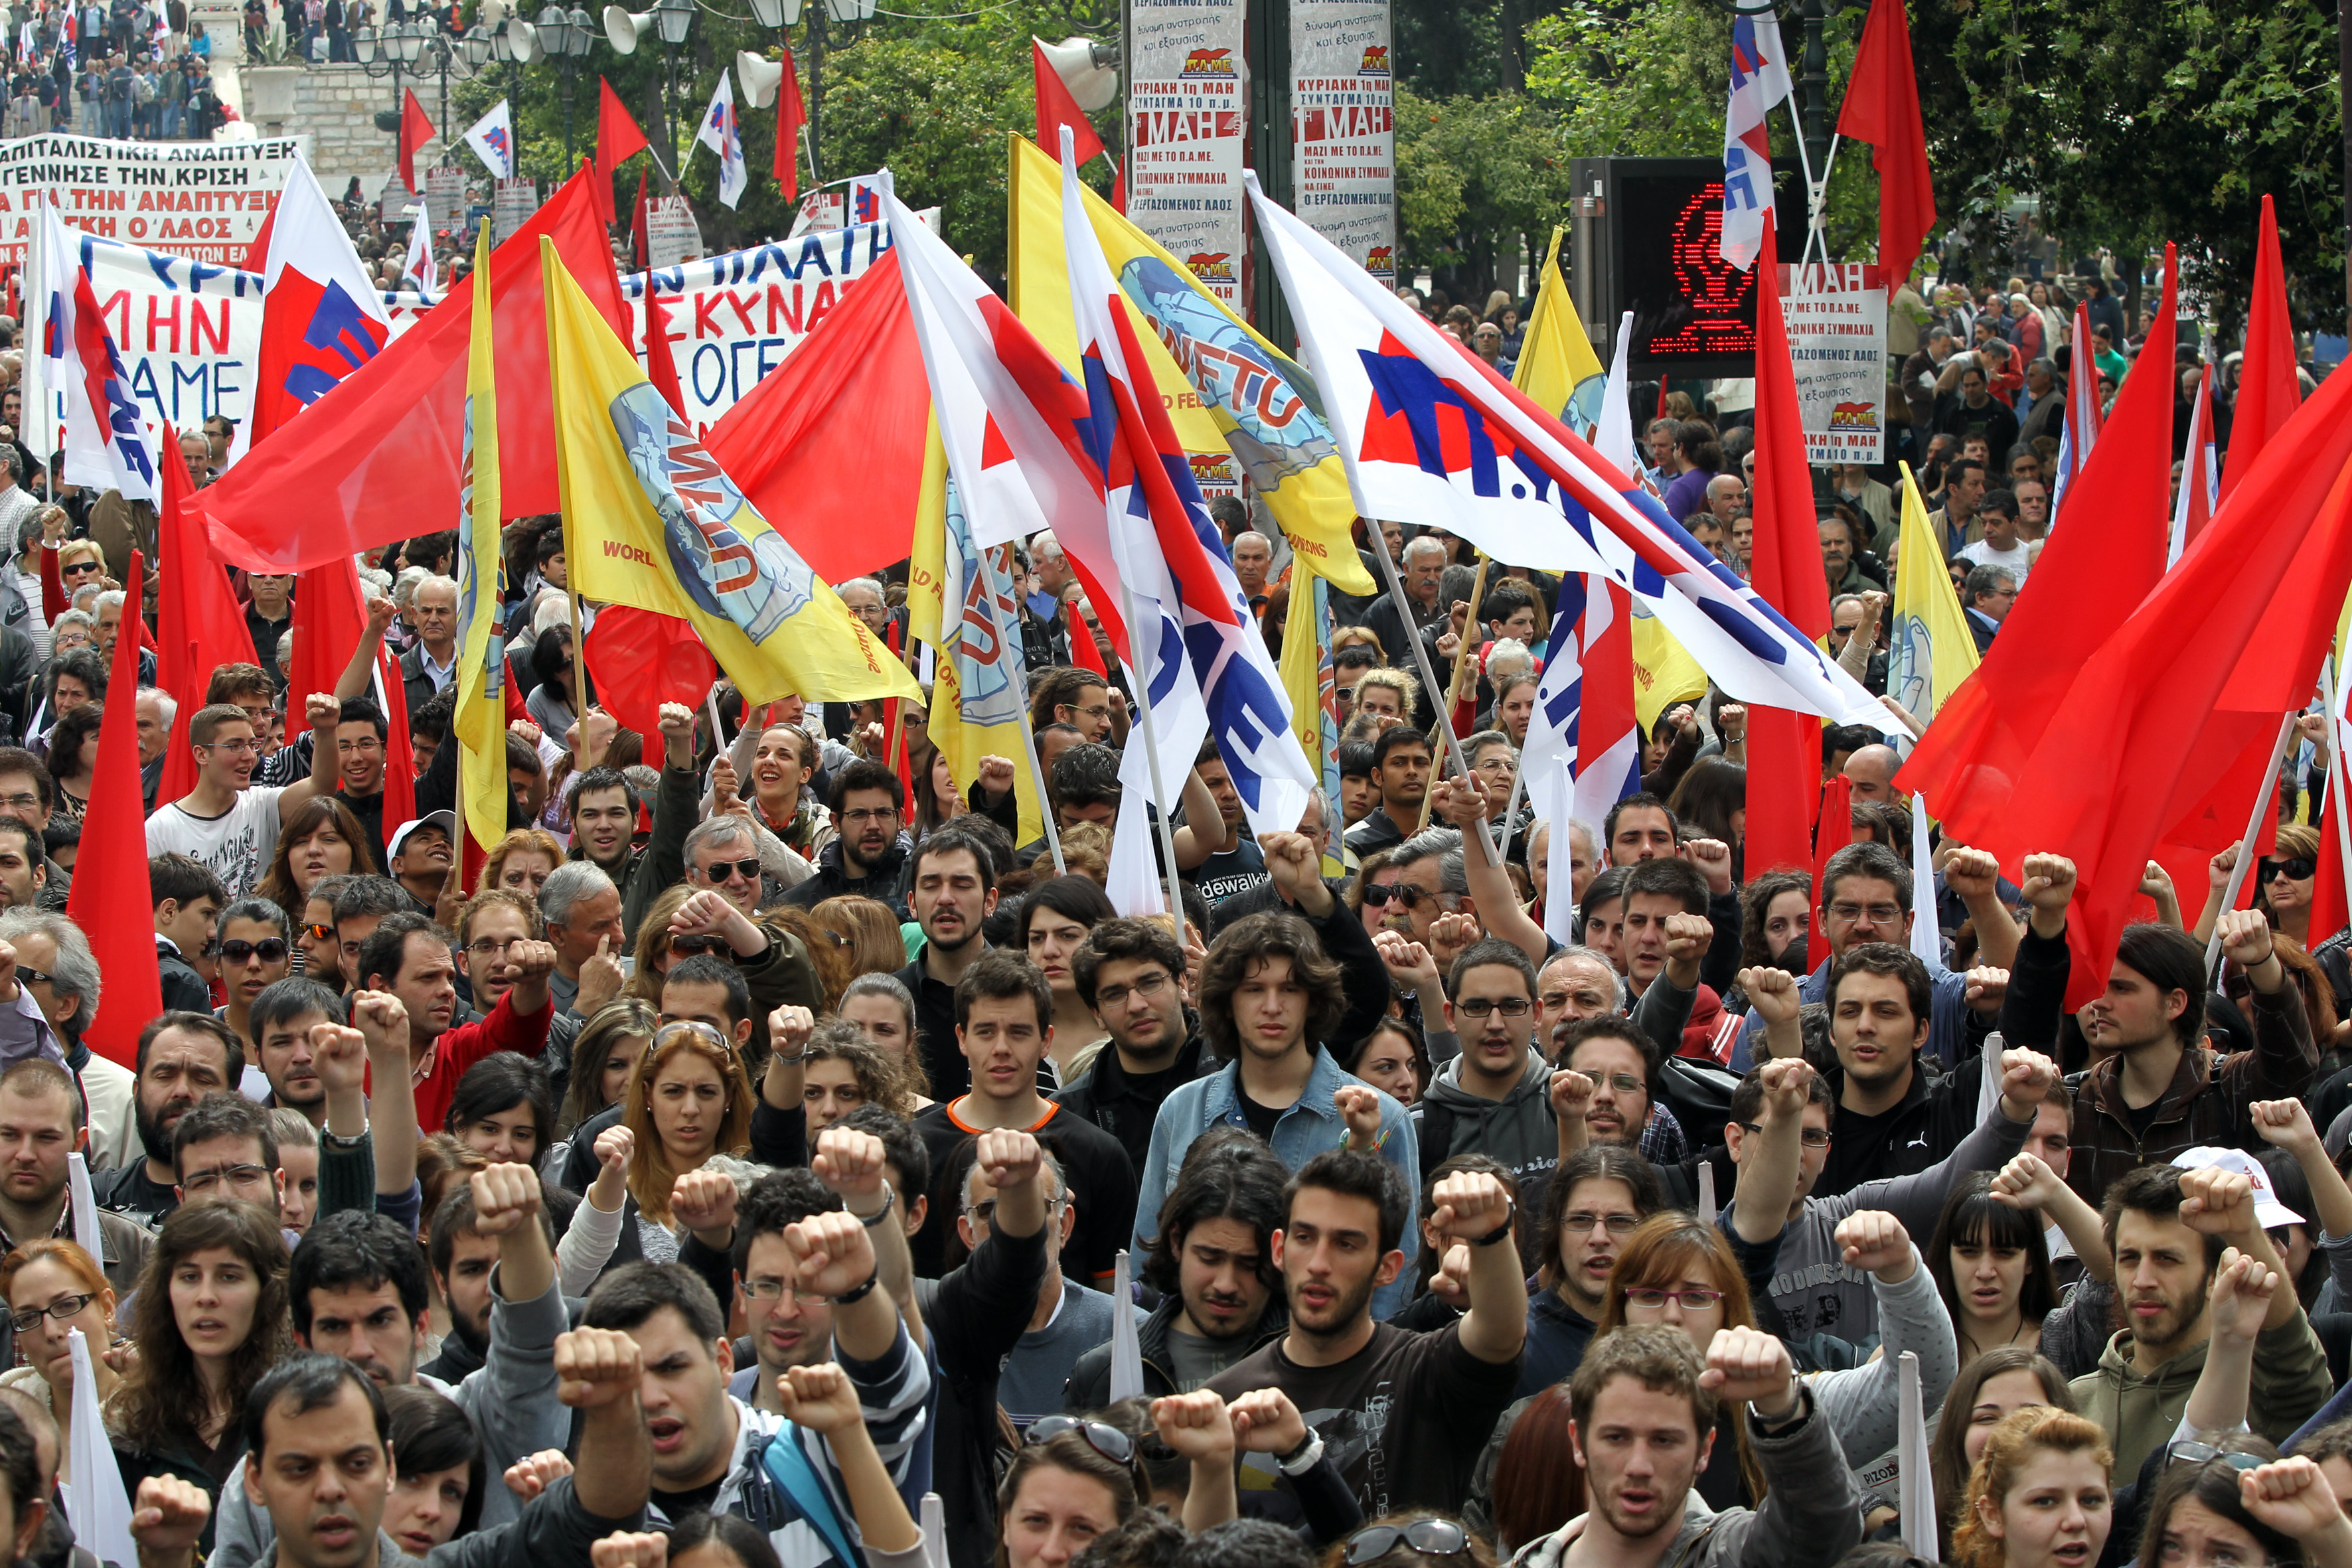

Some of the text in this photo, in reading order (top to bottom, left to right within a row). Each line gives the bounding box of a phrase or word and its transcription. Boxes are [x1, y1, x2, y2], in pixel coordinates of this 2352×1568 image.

[1166, 14, 1221, 28] ανατροπής
[1158, 33, 1205, 49] εξουσίας
[1336, 31, 1375, 46] εξουσίας
[1134, 82, 1233, 96] ΚΥΡΙΑΚΗ 1η ΜΑΗ
[1298, 79, 1390, 92] ΚΥΡΙΑΚΗ 1η ΜΑΗ
[1135, 97, 1183, 108] ΣΥΝΤΑΓΜΑ
[1189, 97, 1202, 108] 10
[1301, 94, 1362, 105] ΣΥΝΤΑΓΜΑ
[1366, 94, 1375, 105] 10
[1148, 112, 1216, 145] ΜΑΗ
[1324, 107, 1383, 139] ΜΑΗ
[0, 139, 297, 163] ΑΠΙΤΑΛΙΣΤΙΚΗ ΑΝΑΠΤΥΞΗ
[1137, 151, 1214, 162] ΜΑΖΙ ΜΕ ΤΟ Π.Α.ΜΕ.
[1304, 146, 1327, 157] ΜΑΖΙ
[1331, 146, 1344, 156] ΜΕ
[1347, 146, 1358, 156] ΤΟ
[3, 164, 248, 186] ΓΕΝΝΗΣΕ ΤΗΝ ΚΡΙΣΗ
[1137, 173, 1227, 185] ΚΟΙΝΩΝΙΚΗ ΣΥΜΜΑΧΙΑ
[1304, 167, 1389, 179] ΚΟΙΝΩΝΙΚΗ ΣΥΜΜΑΧΙΑ
[70, 189, 125, 210] ΤΗΝ
[137, 190, 282, 212] ΑΝΑΠΤΥΞΗ
[1139, 199, 1202, 210] ΕΡΓΑΖΟΜΕΝΟΣ
[1205, 199, 1232, 210] ΛΑΟΣ
[1304, 193, 1391, 205] Ο ΕΡΓΑΖΟΜΕΝΟΣ ΛΑΟΣ
[129, 217, 147, 238] Ο
[159, 217, 232, 238] ΛΑΟΣ
[1166, 219, 1219, 233] ανατροπής
[1160, 237, 1204, 250] ξουσίας
[1340, 232, 1380, 247] εξουσίας
[1790, 264, 1864, 296] ΜΑΗ
[623, 279, 857, 345] ΣΚΥΝΑ
[1796, 303, 1810, 313] ΜΕ
[1814, 303, 1826, 313] ΤΟ
[1830, 303, 1863, 313] Π.Α.ΜΕ.
[1828, 323, 1874, 335] ΣΥΜΜΑΧΙΑ
[1853, 350, 1878, 361] ΛΑΟΣ
[1805, 387, 1851, 402] εξουσίας
[1830, 434, 1842, 447] 1η
[1847, 435, 1877, 447] ΜΑΗ
[1834, 449, 1847, 459] 10
[603, 540, 657, 568] WORL
